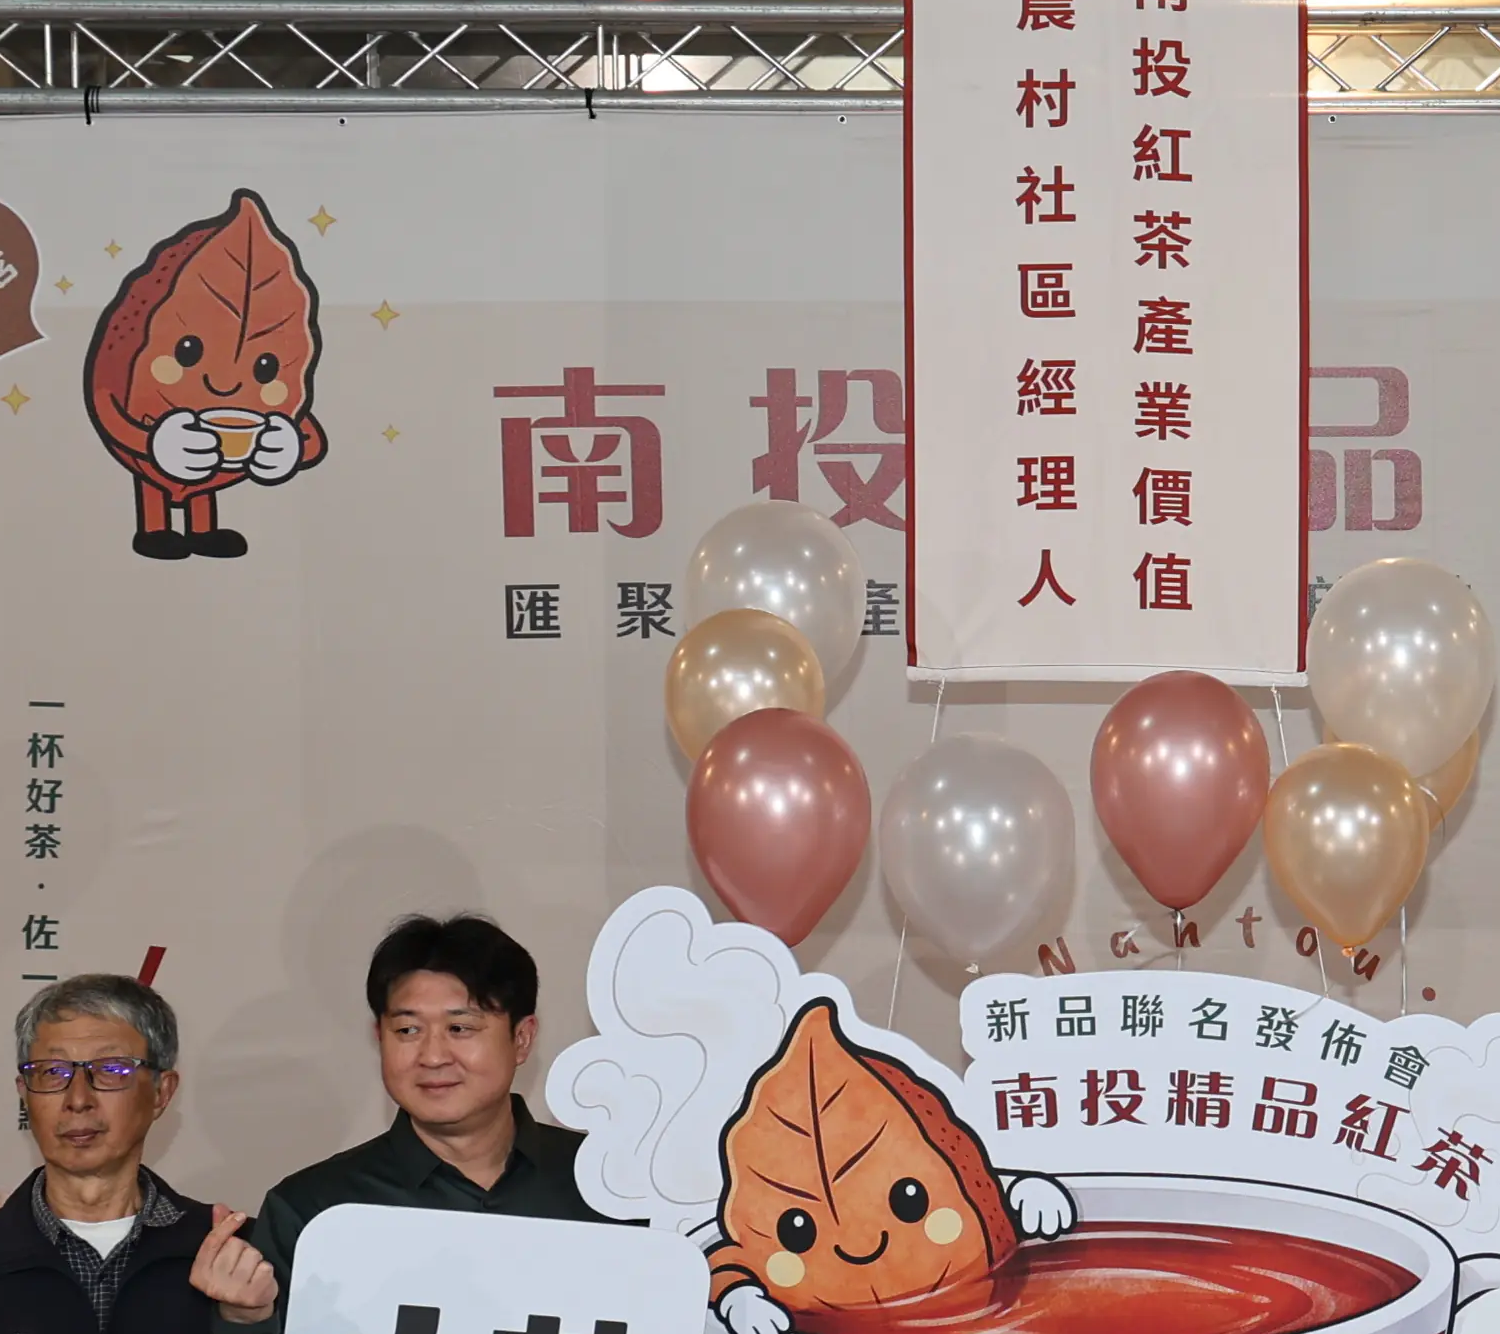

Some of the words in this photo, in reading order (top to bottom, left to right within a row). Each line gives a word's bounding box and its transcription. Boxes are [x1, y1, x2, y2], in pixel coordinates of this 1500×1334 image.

[985, 993, 1431, 1091] 新品聯名發佈會
[991, 1069, 1494, 1202] 南投精品紅茶
